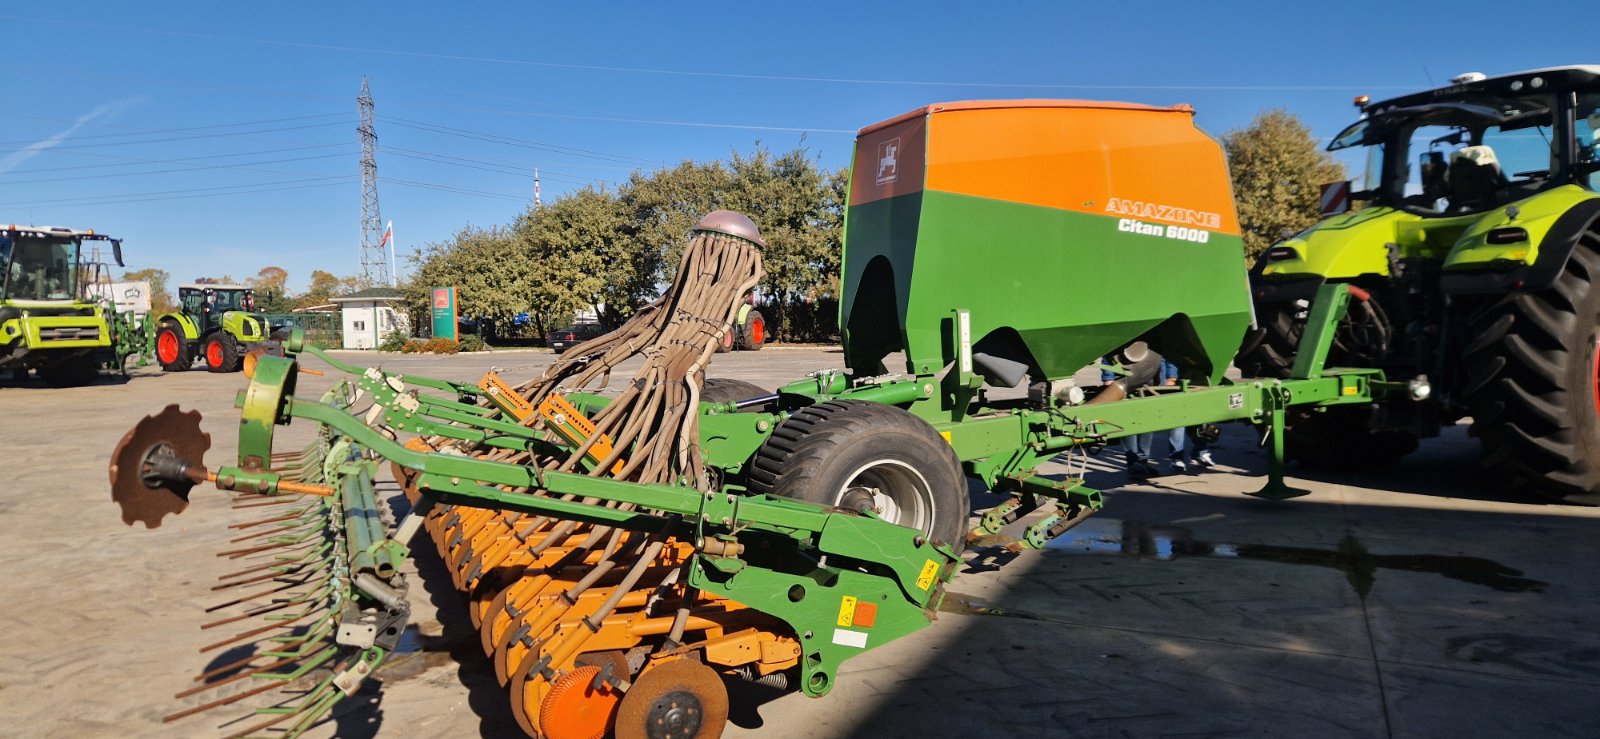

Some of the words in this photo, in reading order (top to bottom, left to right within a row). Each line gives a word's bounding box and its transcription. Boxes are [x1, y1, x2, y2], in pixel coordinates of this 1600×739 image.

[1105, 198, 1220, 228] AMAZONE
[1118, 218, 1163, 236] Citan
[1166, 225, 1209, 243] 6000
